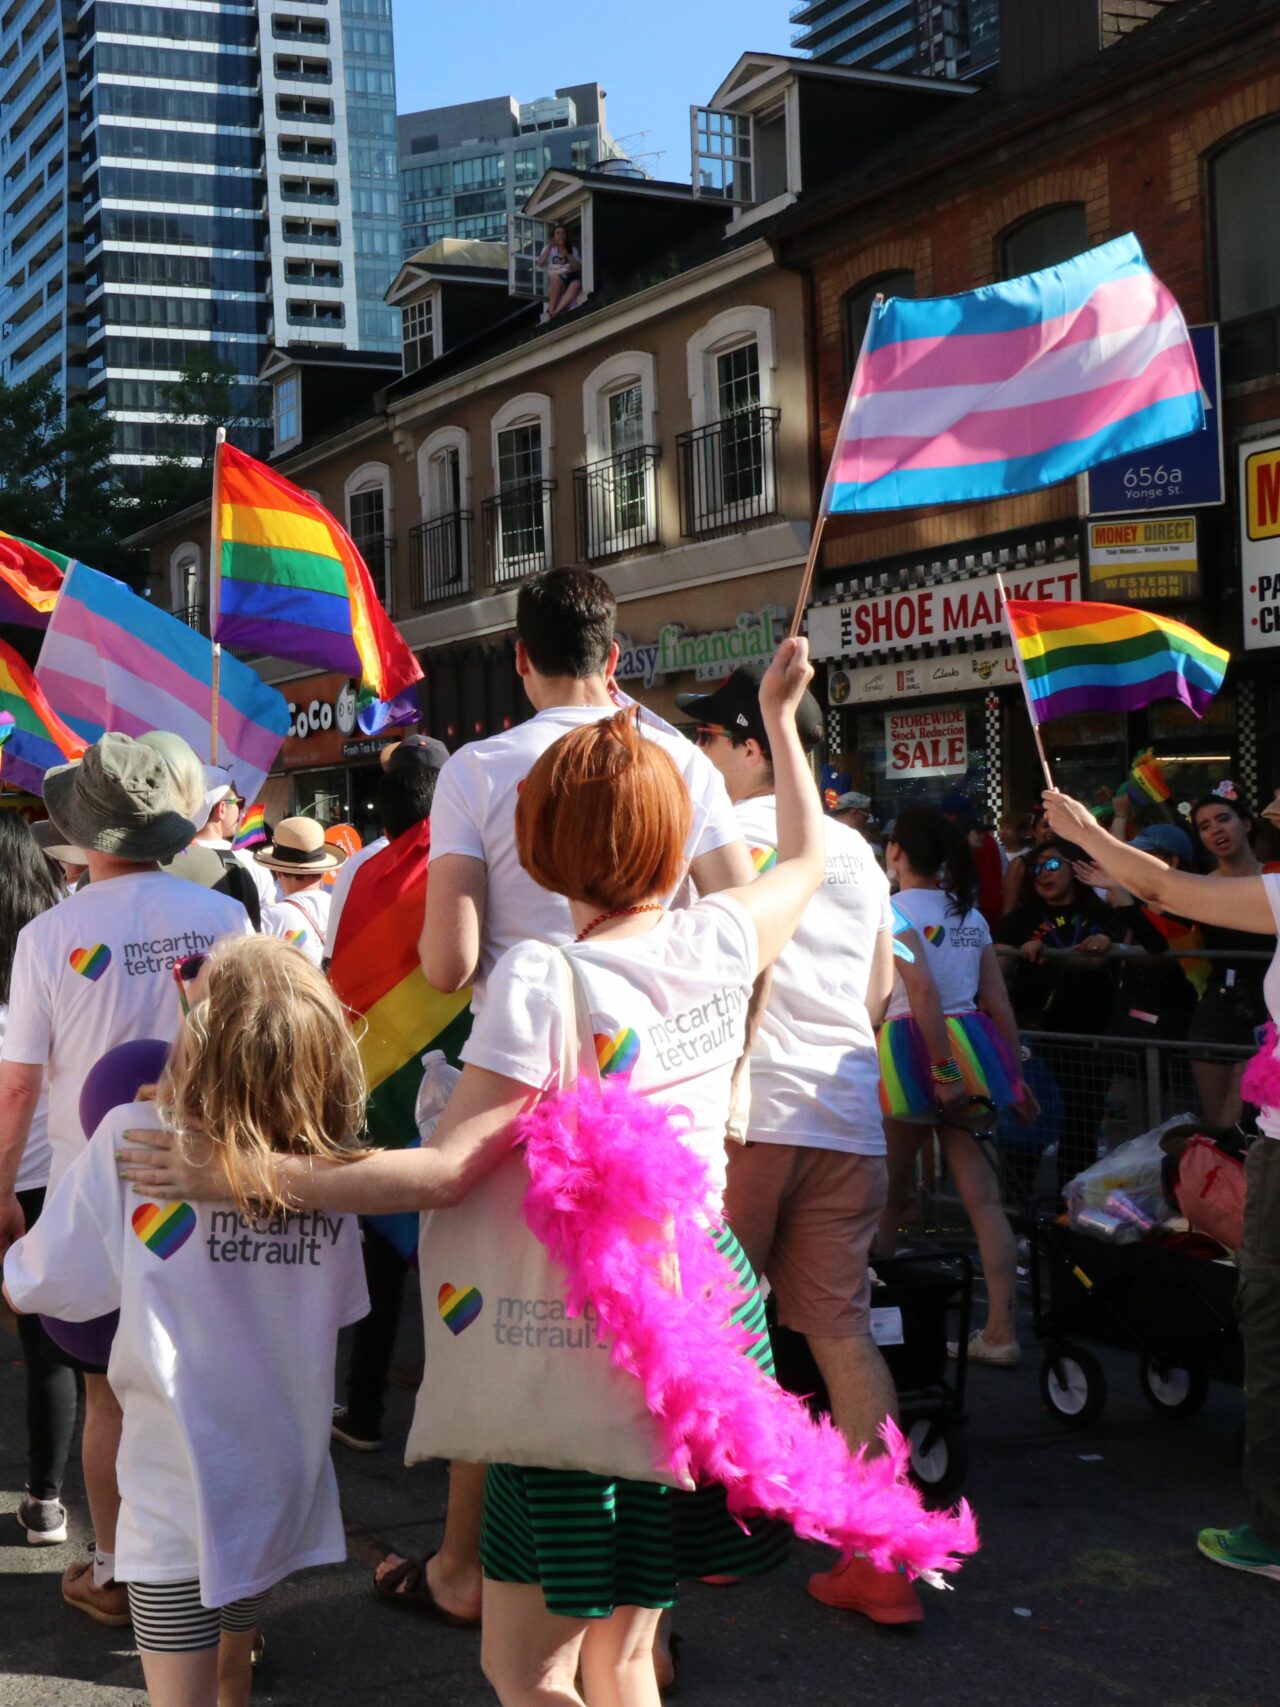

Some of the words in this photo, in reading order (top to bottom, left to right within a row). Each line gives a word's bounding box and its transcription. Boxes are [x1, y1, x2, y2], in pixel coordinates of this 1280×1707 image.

[1123, 465, 1182, 487] 656a
[1125, 489, 1163, 498] Yonge
[1095, 526, 1138, 544] MONEY
[1144, 522, 1191, 541] DIRECT
[1105, 575, 1179, 589] WESTERN
[1128, 586, 1179, 599] UNION
[841, 606, 852, 649] THE
[855, 592, 933, 645] SHOE
[943, 573, 1078, 632] MARKET
[890, 710, 964, 730] STOREWIDE
[891, 729, 916, 741] Stock
[919, 726, 964, 739] Reduction
[892, 737, 965, 771] SALE
[124, 931, 214, 960] mccarthy
[648, 986, 742, 1046] mccarthy
[655, 1015, 735, 1072] tetrault
[207, 1234, 322, 1265] tetrault
